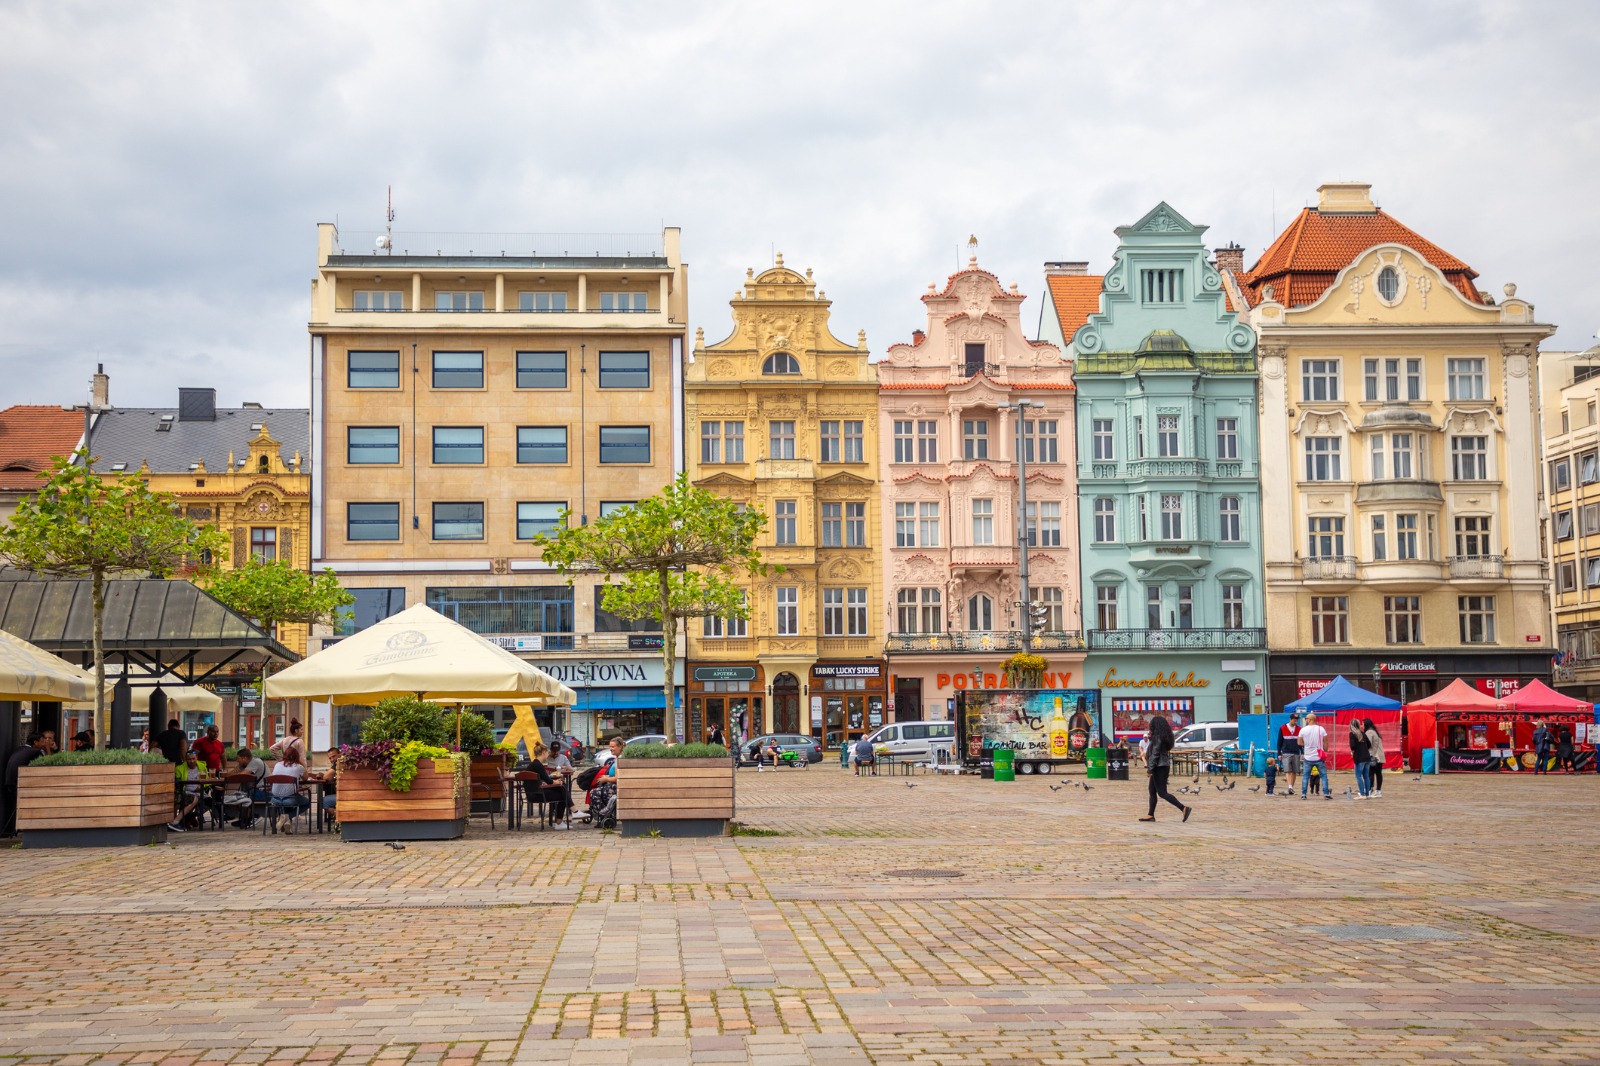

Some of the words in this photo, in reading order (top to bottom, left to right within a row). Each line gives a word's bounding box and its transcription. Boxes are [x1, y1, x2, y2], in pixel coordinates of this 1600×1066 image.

[1388, 663, 1417, 671] UniCredit
[1418, 663, 1435, 671] Bank
[937, 672, 1072, 690] POTRANY
[1098, 668, 1210, 688] Samoobsluha
[1299, 680, 1331, 688] Prémiov
[1459, 712, 1525, 721] ČERSTVÉ
[1029, 741, 1047, 750] BAR
